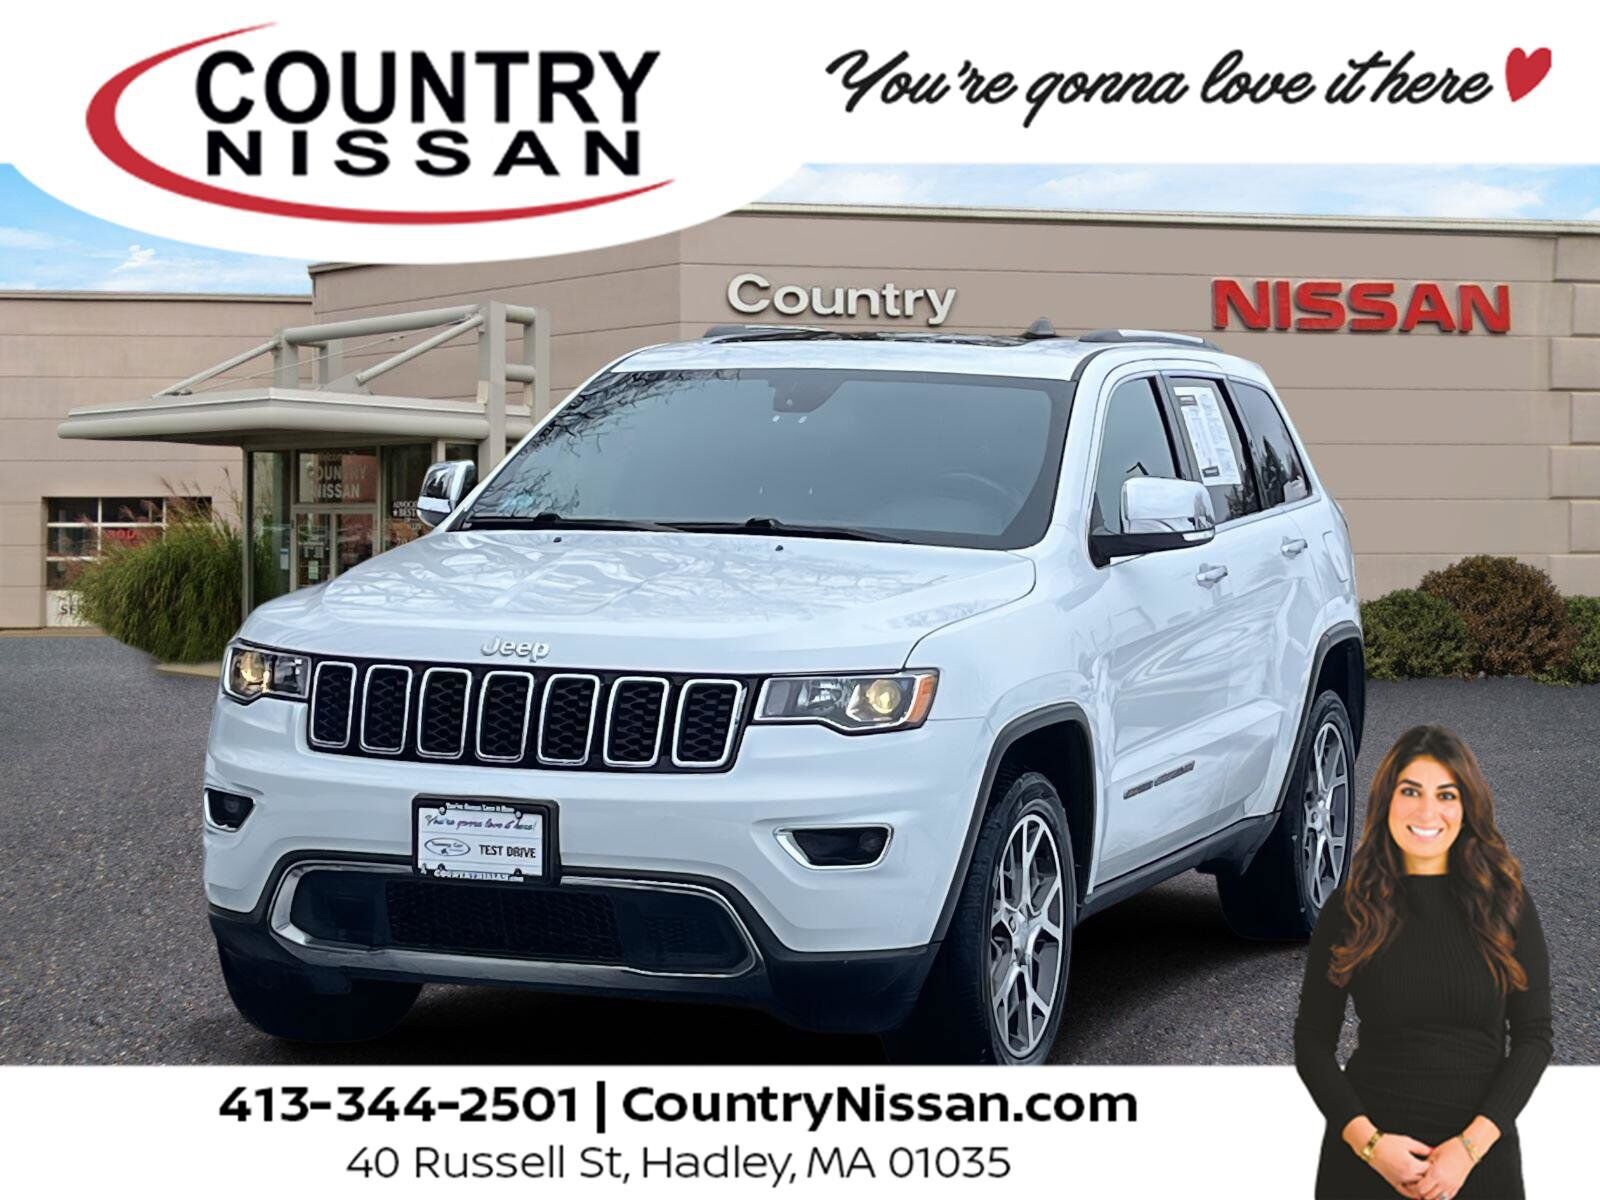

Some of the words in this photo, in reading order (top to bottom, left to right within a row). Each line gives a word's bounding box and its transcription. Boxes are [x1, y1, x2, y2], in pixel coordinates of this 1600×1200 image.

[728, 273, 957, 327] Country
[1212, 279, 1511, 333] NISSAN
[313, 483, 360, 498] NISSAN
[480, 635, 550, 663] Jeep
[479, 845, 504, 856] TEST
[506, 846, 536, 858] DRIVE
